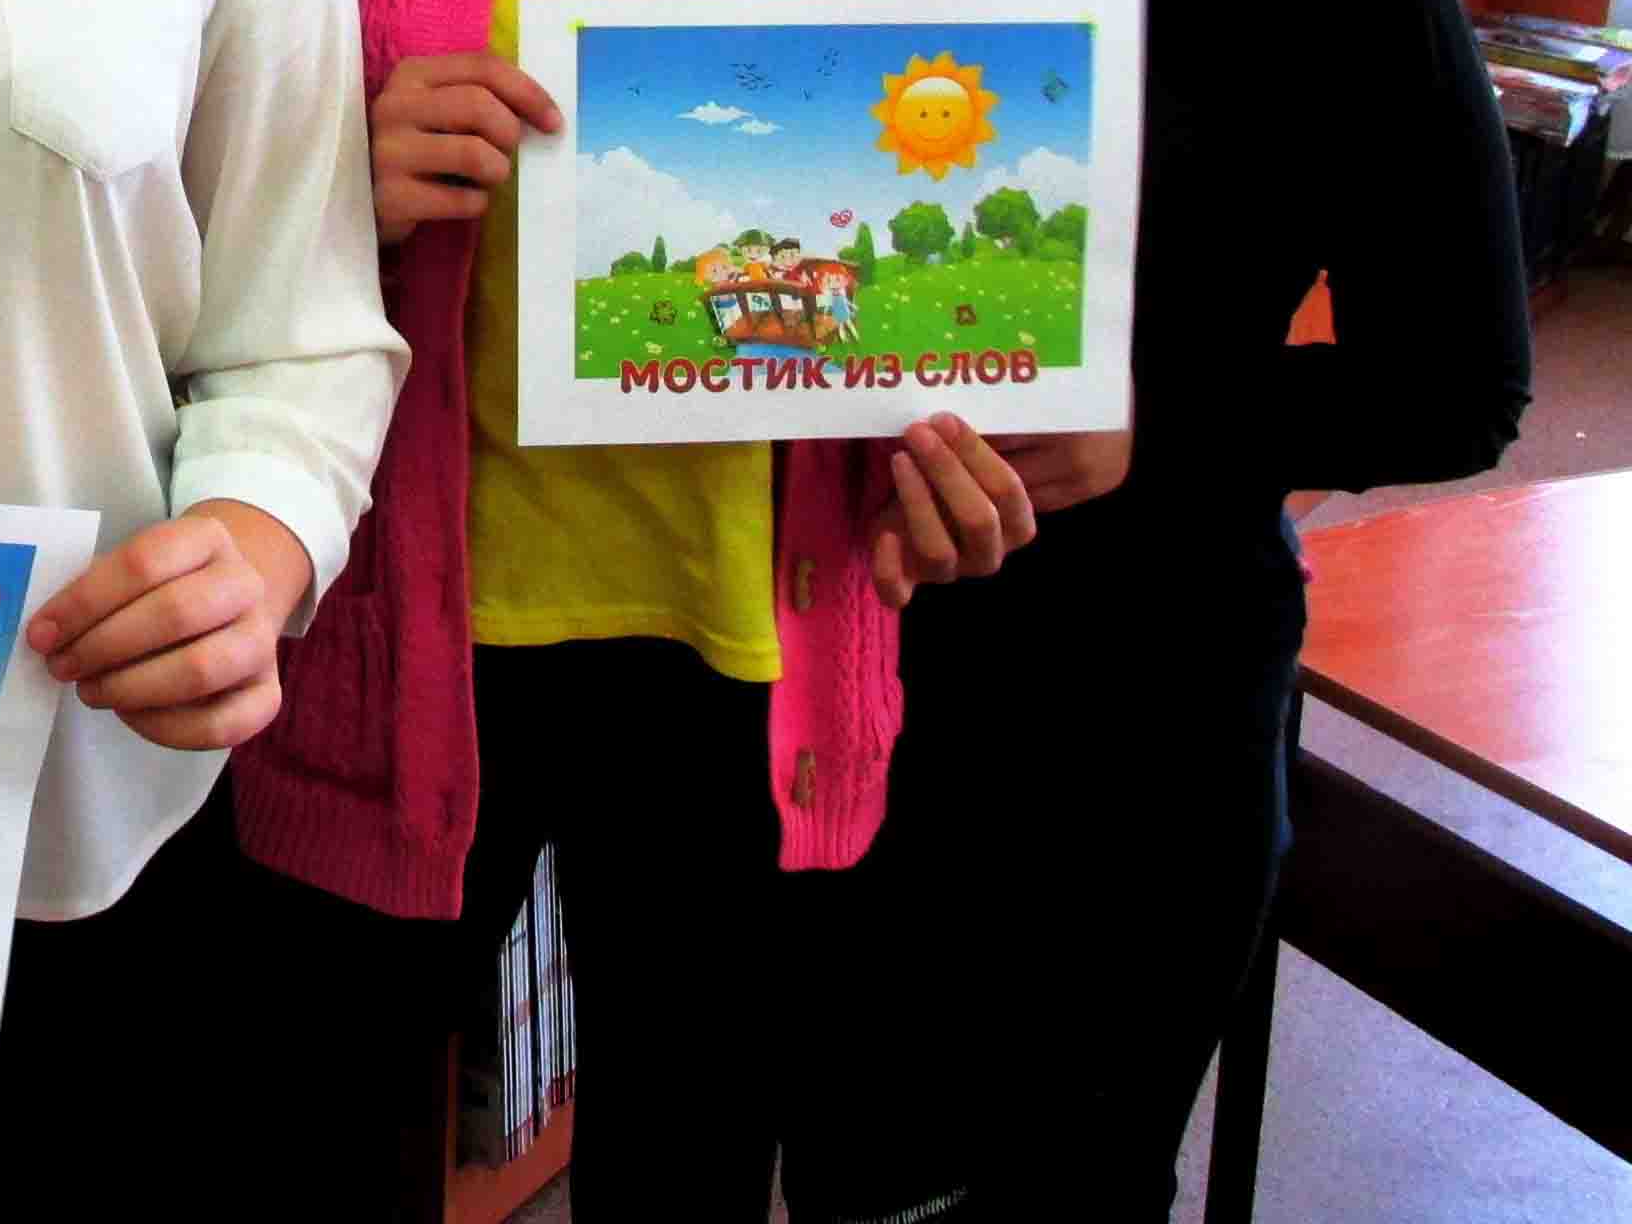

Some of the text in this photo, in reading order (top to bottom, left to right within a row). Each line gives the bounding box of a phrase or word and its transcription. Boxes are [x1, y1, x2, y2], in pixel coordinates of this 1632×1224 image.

[618, 348, 1040, 395] МОСТИК ИЗ СЛОВ
